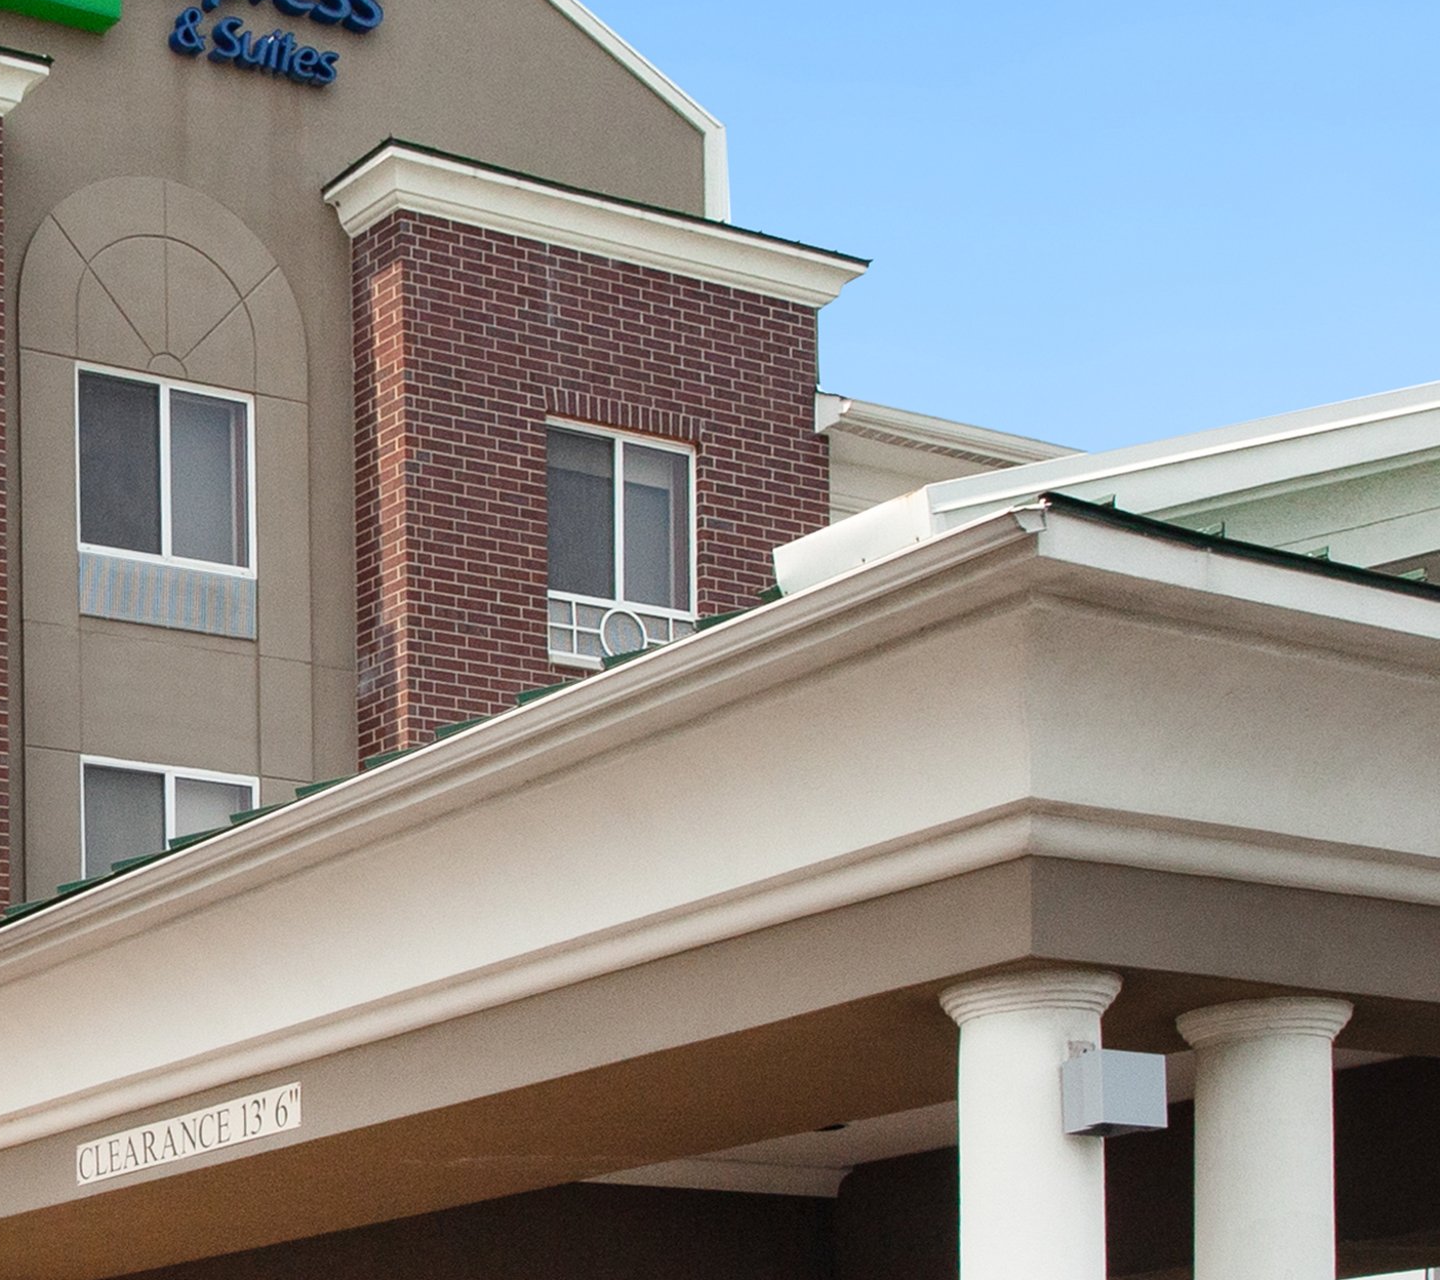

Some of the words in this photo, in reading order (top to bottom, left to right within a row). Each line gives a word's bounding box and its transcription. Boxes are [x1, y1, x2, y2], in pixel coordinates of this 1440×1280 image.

[168, 6, 207, 56] &
[209, 15, 341, 86] Suites
[78, 1108, 232, 1181] CLEARANCE
